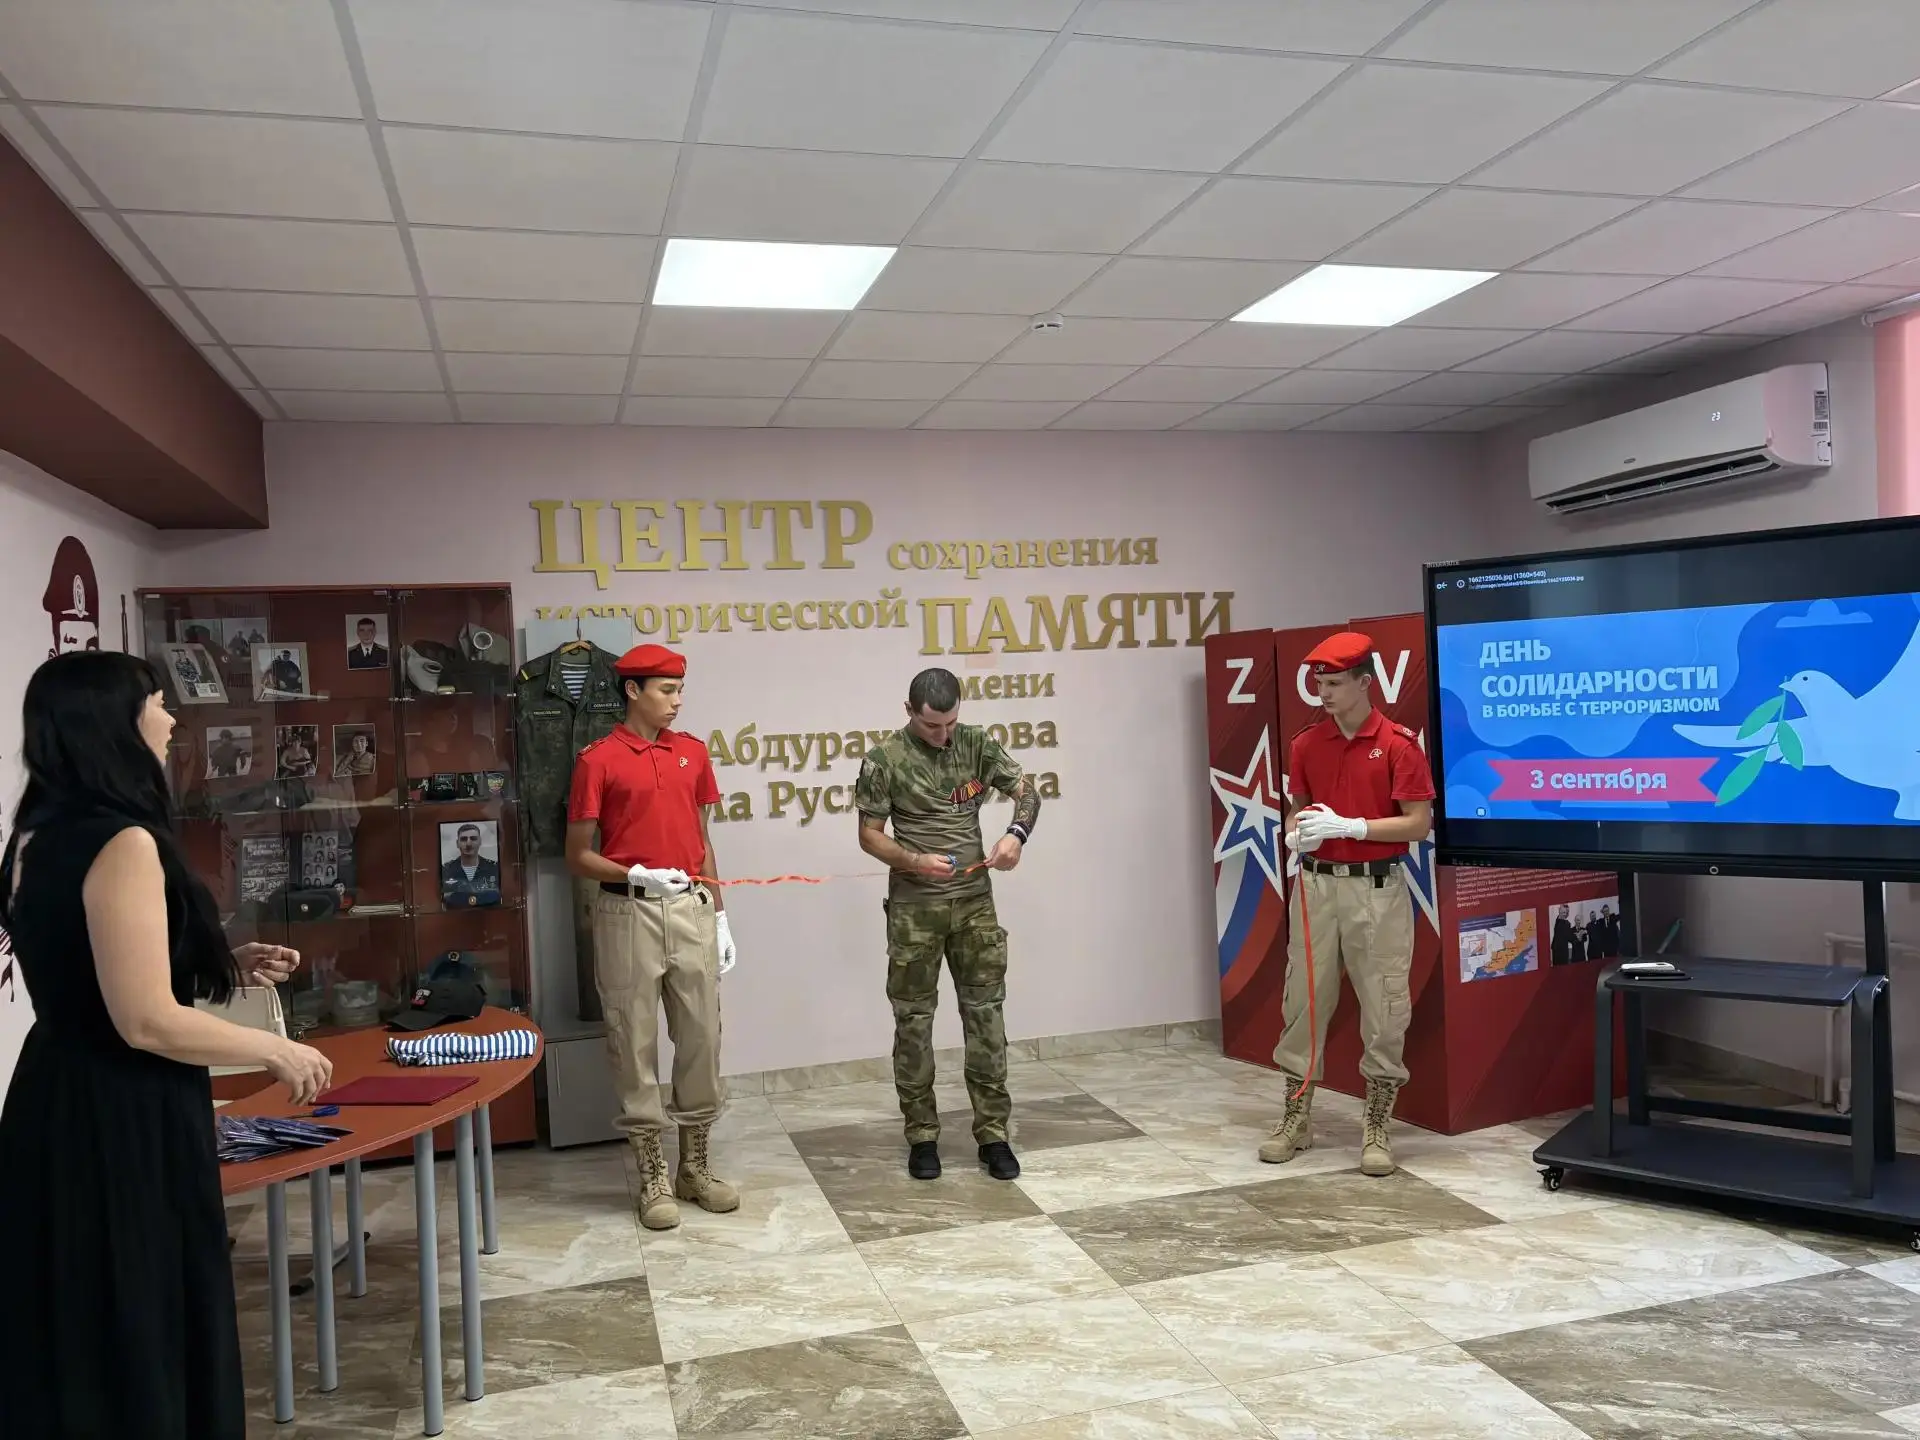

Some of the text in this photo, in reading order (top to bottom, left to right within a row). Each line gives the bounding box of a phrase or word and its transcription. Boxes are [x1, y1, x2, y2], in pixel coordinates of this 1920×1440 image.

[1711, 411, 1721, 421] 23
[529, 500, 1158, 590] ЦЕНТР сохранения
[916, 591, 1235, 655] ПАМЯТИ
[1479, 639, 1551, 669] ДЕНЬ
[1226, 658, 1256, 704] Z
[1372, 650, 1411, 704] V
[1481, 666, 1718, 699] СОЛИДАРНОСТИ
[1482, 697, 1720, 718] В БОРЬБЕ С ТЕРРОРИЗМОМ
[1530, 768, 1667, 794] 3 сентября
